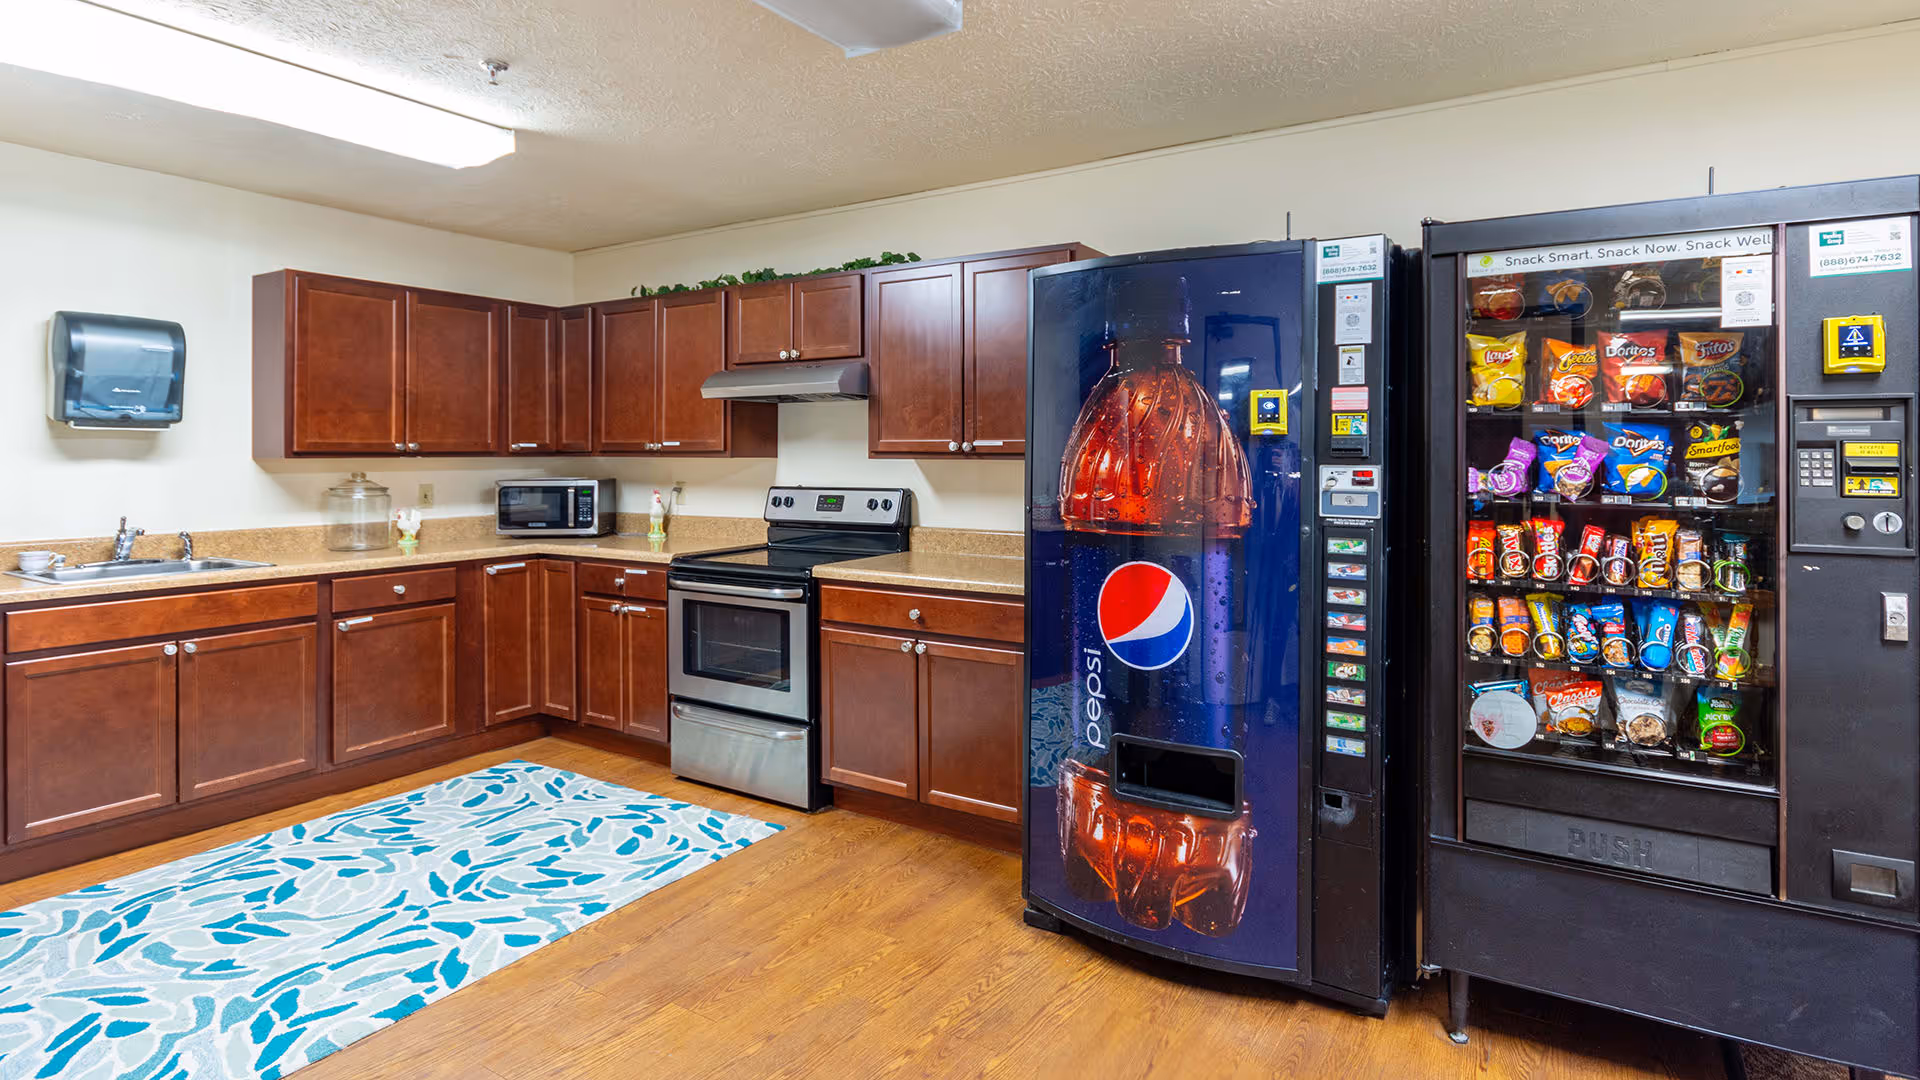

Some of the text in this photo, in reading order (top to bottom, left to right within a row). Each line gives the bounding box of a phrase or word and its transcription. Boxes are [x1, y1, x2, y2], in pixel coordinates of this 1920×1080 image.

[1505, 254, 1545, 267] Snack
[1548, 249, 1593, 263] Smart.
[1597, 245, 1640, 259] Snack
[1645, 243, 1681, 254] Now.
[1686, 237, 1732, 251] Snack
[1819, 253, 1902, 267] (888)674-7632
[1605, 346, 1656, 357] Doritos
[1695, 340, 1735, 359] Fritos
[1540, 435, 1582, 446] Dorito
[1614, 436, 1665, 451] Doritos
[1689, 441, 1740, 457] Smartfood
[1541, 525, 1558, 577] Skittles
[1084, 647, 1106, 749] pepsi
[1548, 687, 1597, 707] Classic
[1568, 827, 1654, 869] PUSH
